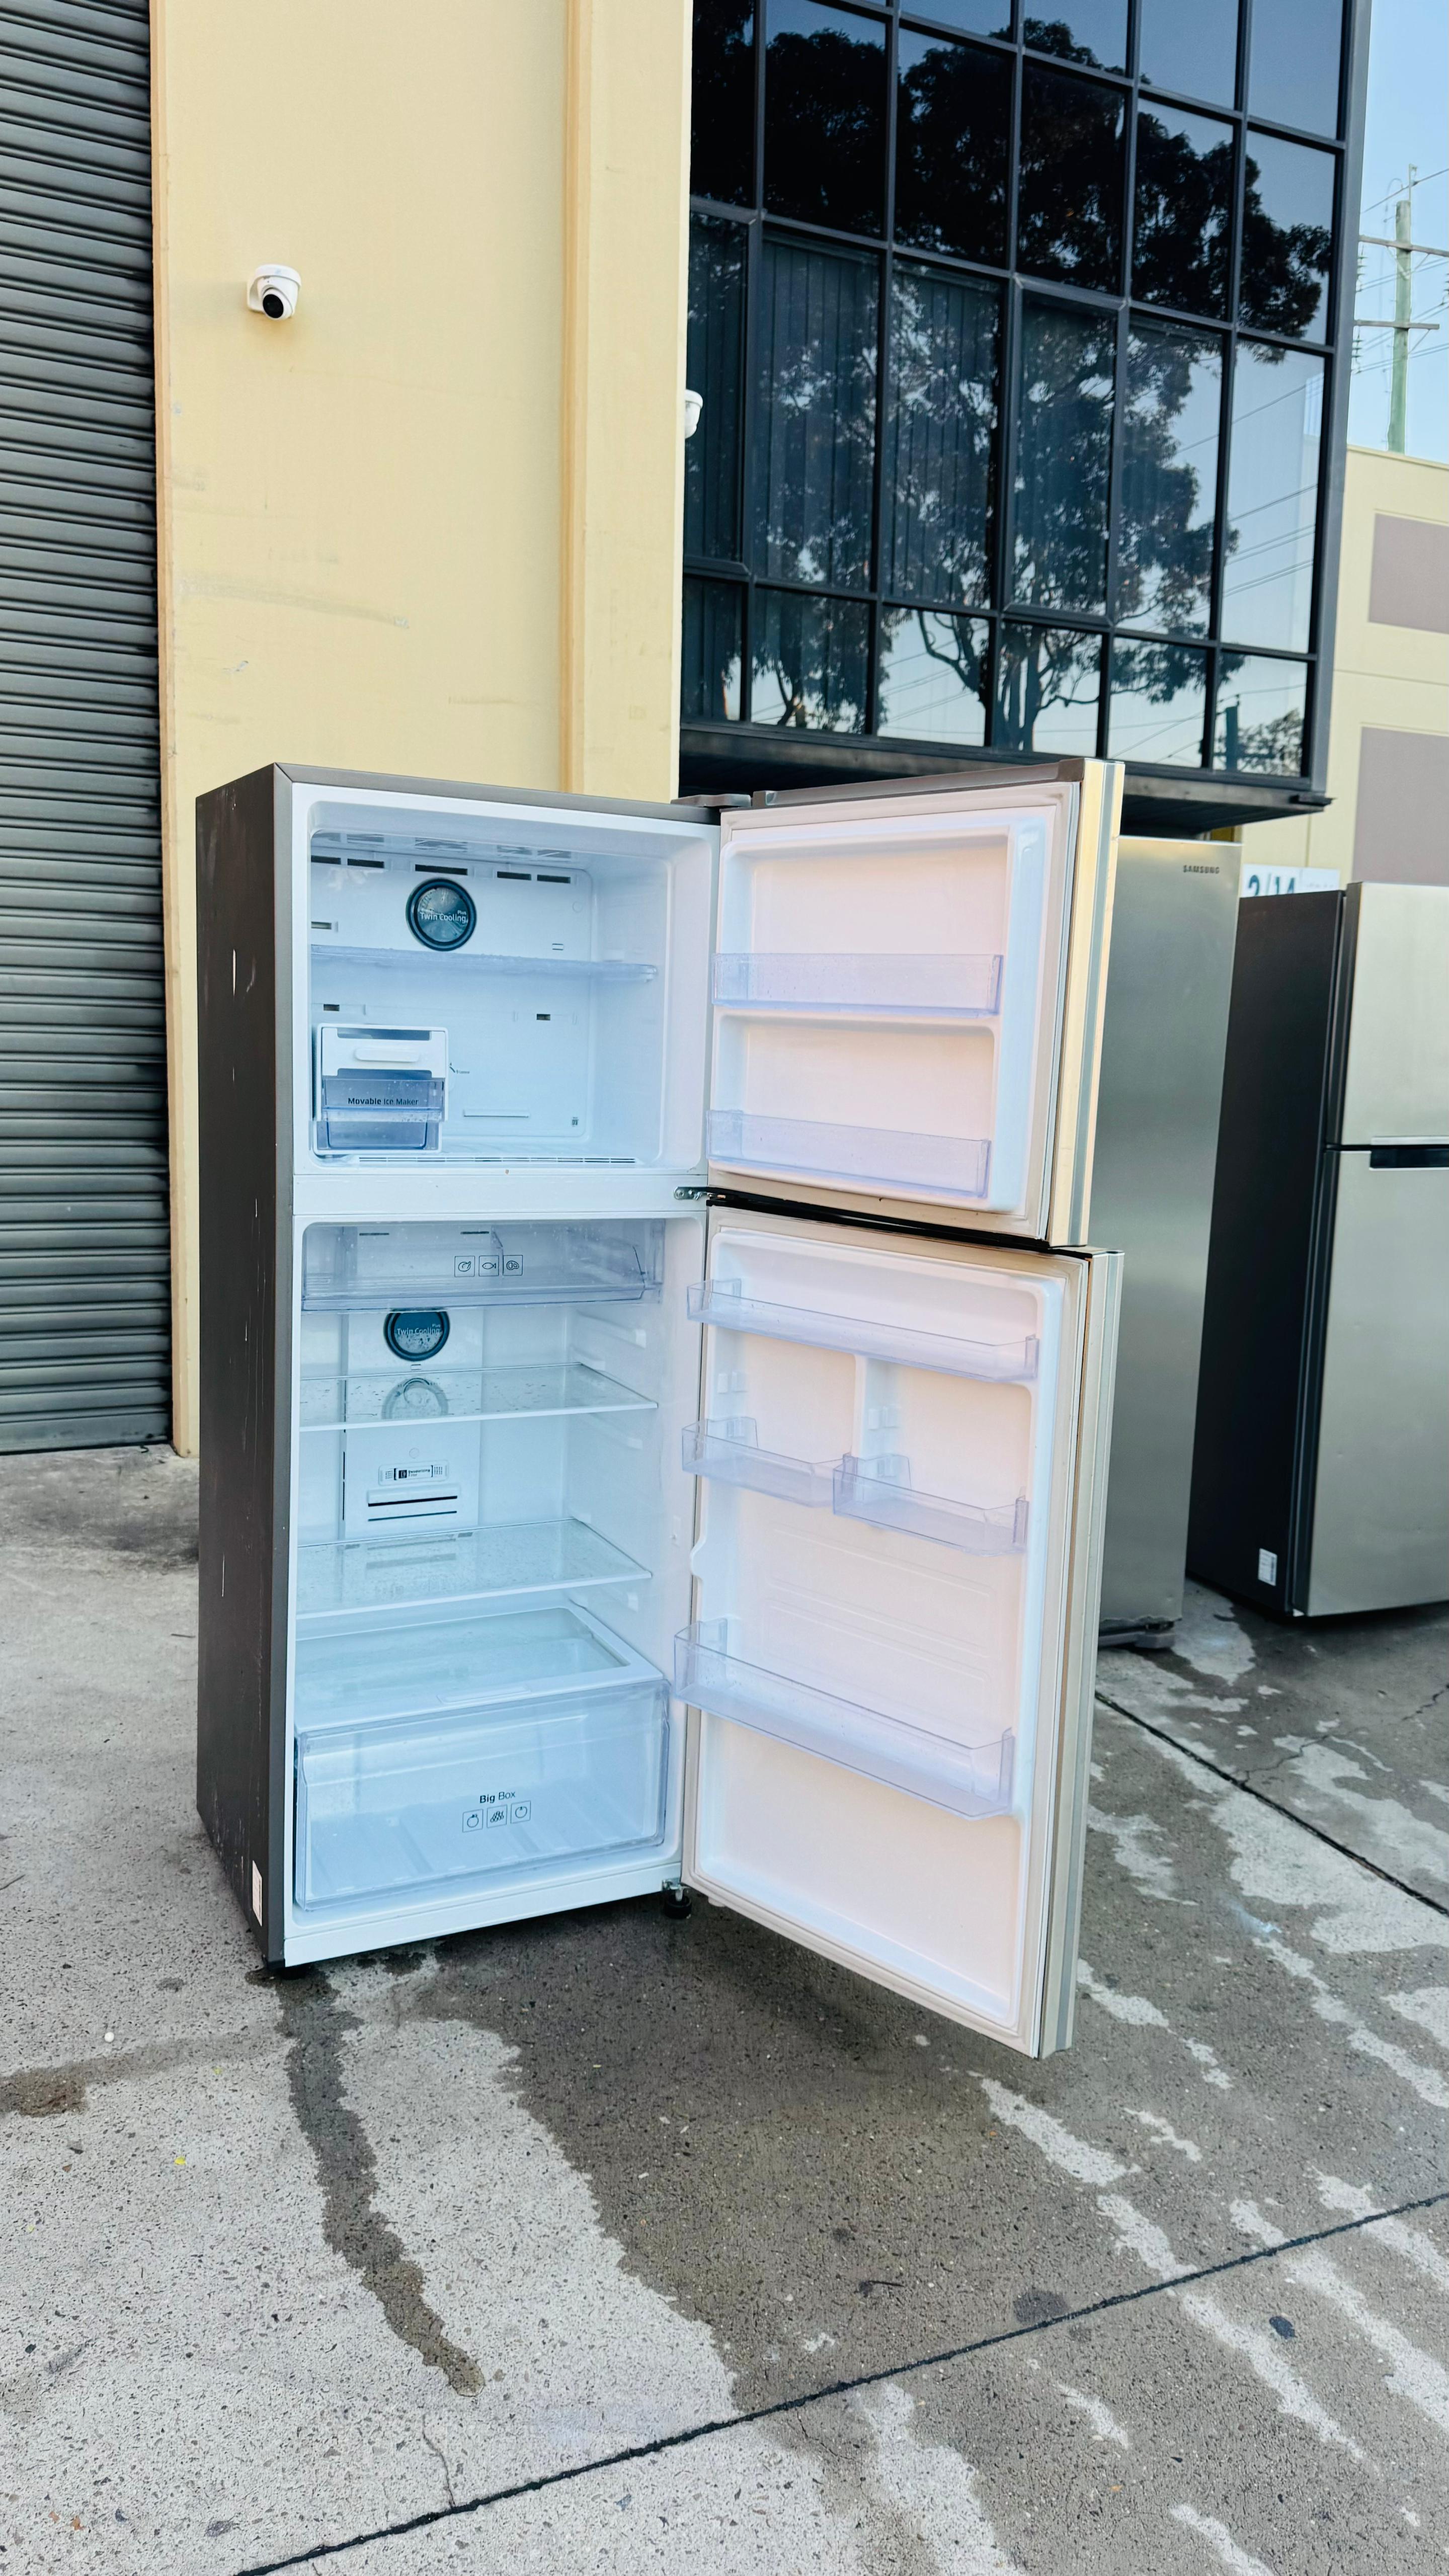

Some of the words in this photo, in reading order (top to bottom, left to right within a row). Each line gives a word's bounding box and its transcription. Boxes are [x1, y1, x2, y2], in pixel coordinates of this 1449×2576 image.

[1183, 865, 1220, 874] SAMSUNG
[420, 912, 437, 921] Twin
[439, 913, 466, 924] Cooling
[397, 1327, 413, 1335] Twin
[479, 1794, 495, 1804] Big
[499, 1791, 516, 1800] Box
